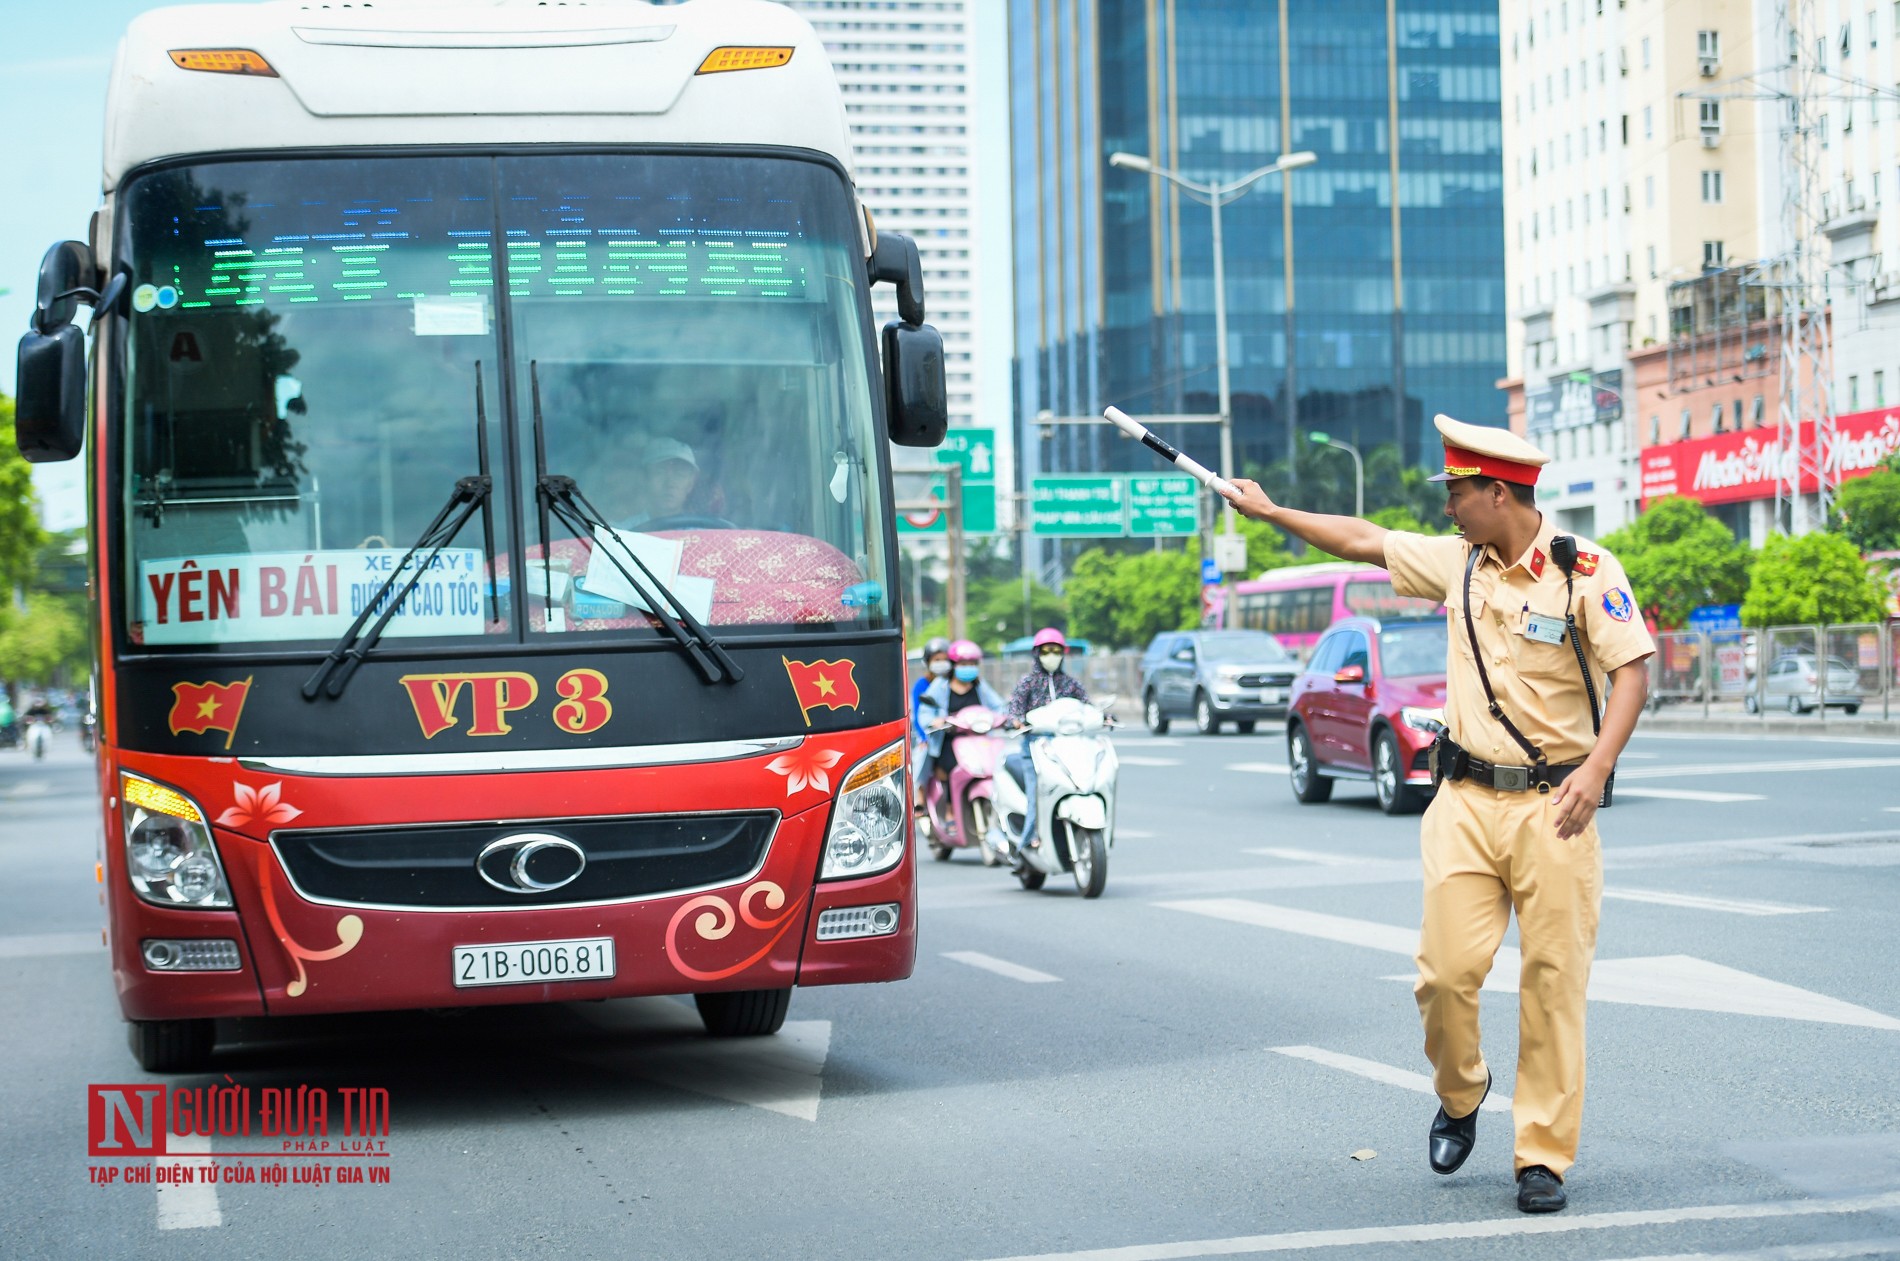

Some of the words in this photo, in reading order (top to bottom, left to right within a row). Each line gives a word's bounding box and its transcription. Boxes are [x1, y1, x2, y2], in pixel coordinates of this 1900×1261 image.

[365, 555, 392, 571] XE
[148, 559, 240, 625] YÊN
[258, 555, 339, 618] BÁI
[411, 581, 443, 616] CAO
[448, 572, 479, 616] TỐC
[398, 671, 539, 740] VP
[552, 668, 613, 734] 3
[460, 944, 605, 981] 21B-006.81
